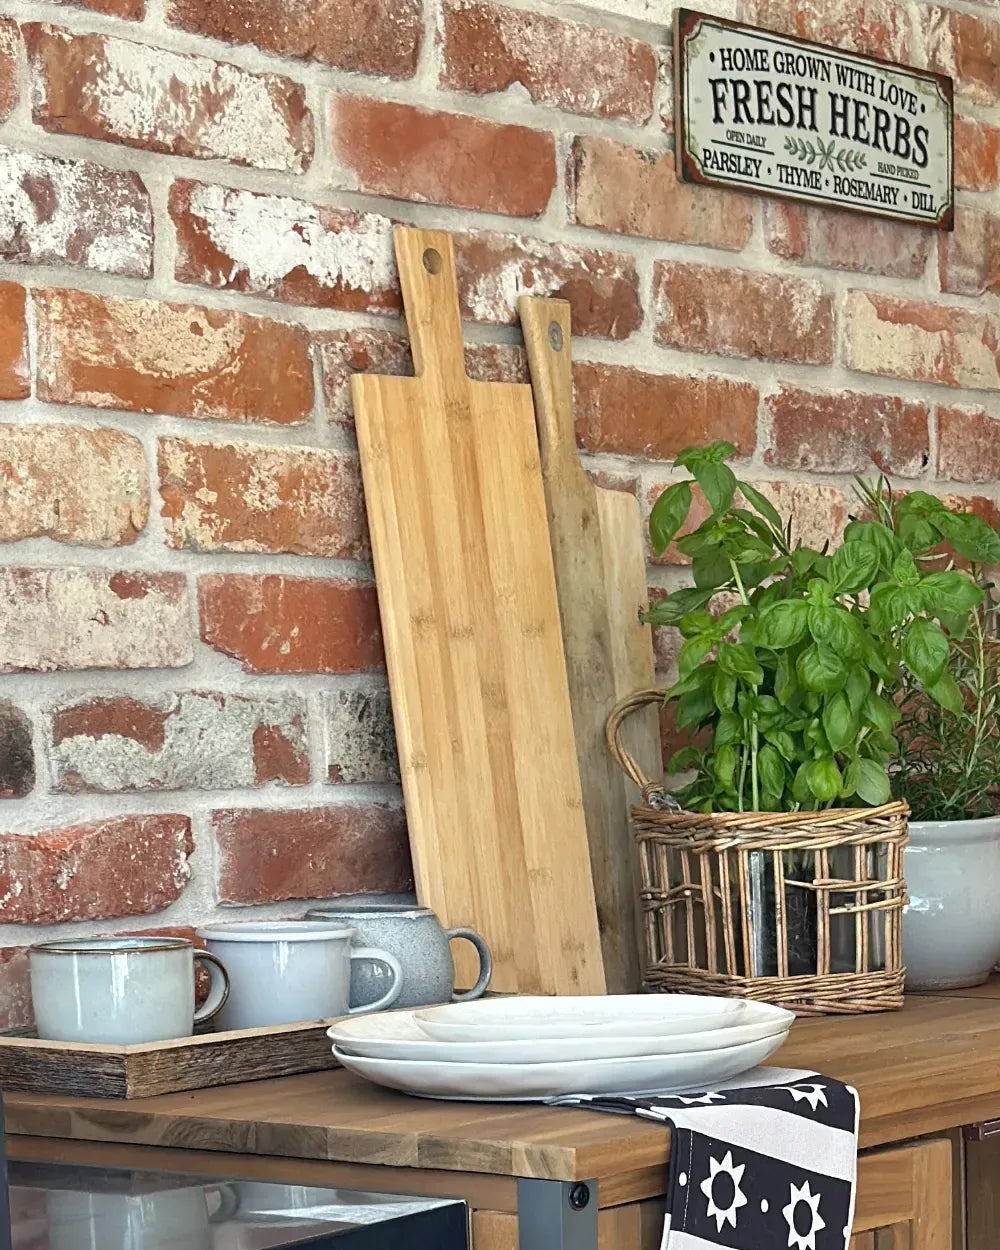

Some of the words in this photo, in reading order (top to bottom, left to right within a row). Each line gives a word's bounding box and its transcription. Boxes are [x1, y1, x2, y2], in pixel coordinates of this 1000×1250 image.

[720, 48, 770, 72] HOME
[773, 51, 832, 82] GROWN
[835, 63, 875, 97] WITH
[879, 79, 918, 116] LOVE
[708, 78, 819, 132] FRESH
[828, 91, 929, 168] HERBS
[726, 130, 745, 145] OPEN
[746, 133, 767, 148] DAILY
[702, 148, 762, 178] PARSLEY
[776, 163, 822, 190] THYME
[833, 176, 899, 205] ROSEMARY
[912, 191, 937, 213] DILL
[877, 161, 896, 176] HAND
[897, 165, 919, 180] PICKED
